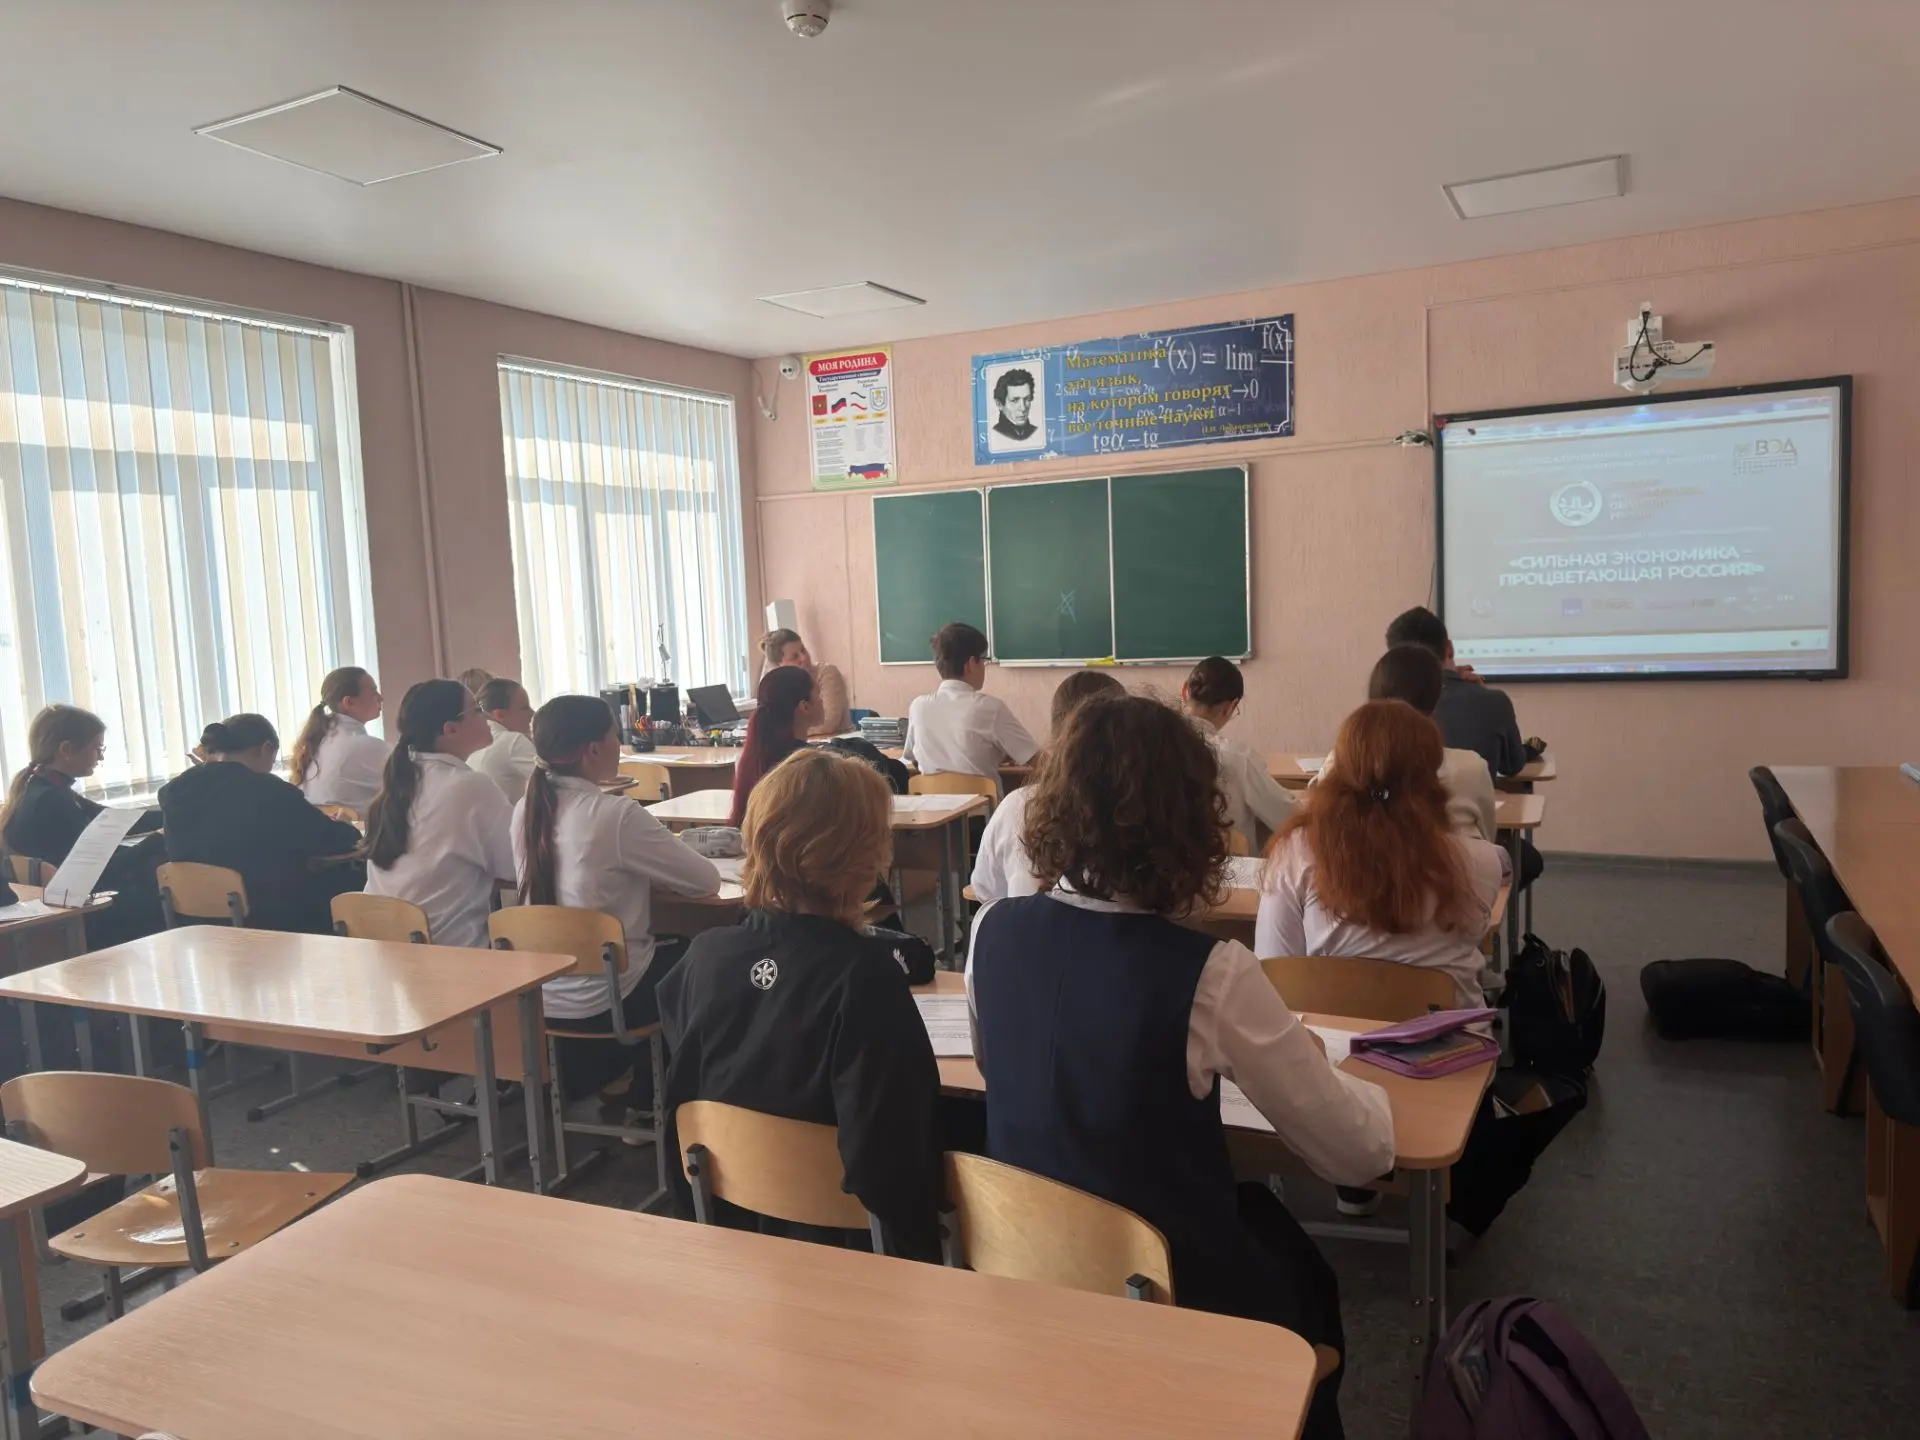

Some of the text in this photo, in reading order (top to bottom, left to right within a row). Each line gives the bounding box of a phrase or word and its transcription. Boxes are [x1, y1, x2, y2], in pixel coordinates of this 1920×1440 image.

[817, 357, 878, 372] МОЯ РОДИНА
[1066, 347, 1167, 370] Математика
[1225, 344, 1254, 370] lim
[1066, 373, 1142, 391] это язык,
[1067, 384, 1233, 413] на котором говорят
[1067, 407, 1215, 433] все точные науки
[1508, 551, 1607, 570] «СИЛЬНАЯ
[1611, 545, 1740, 566] ЭКОНОМИКА
[1498, 565, 1663, 587] ПРОЦВЕТАЮЩАЯ
